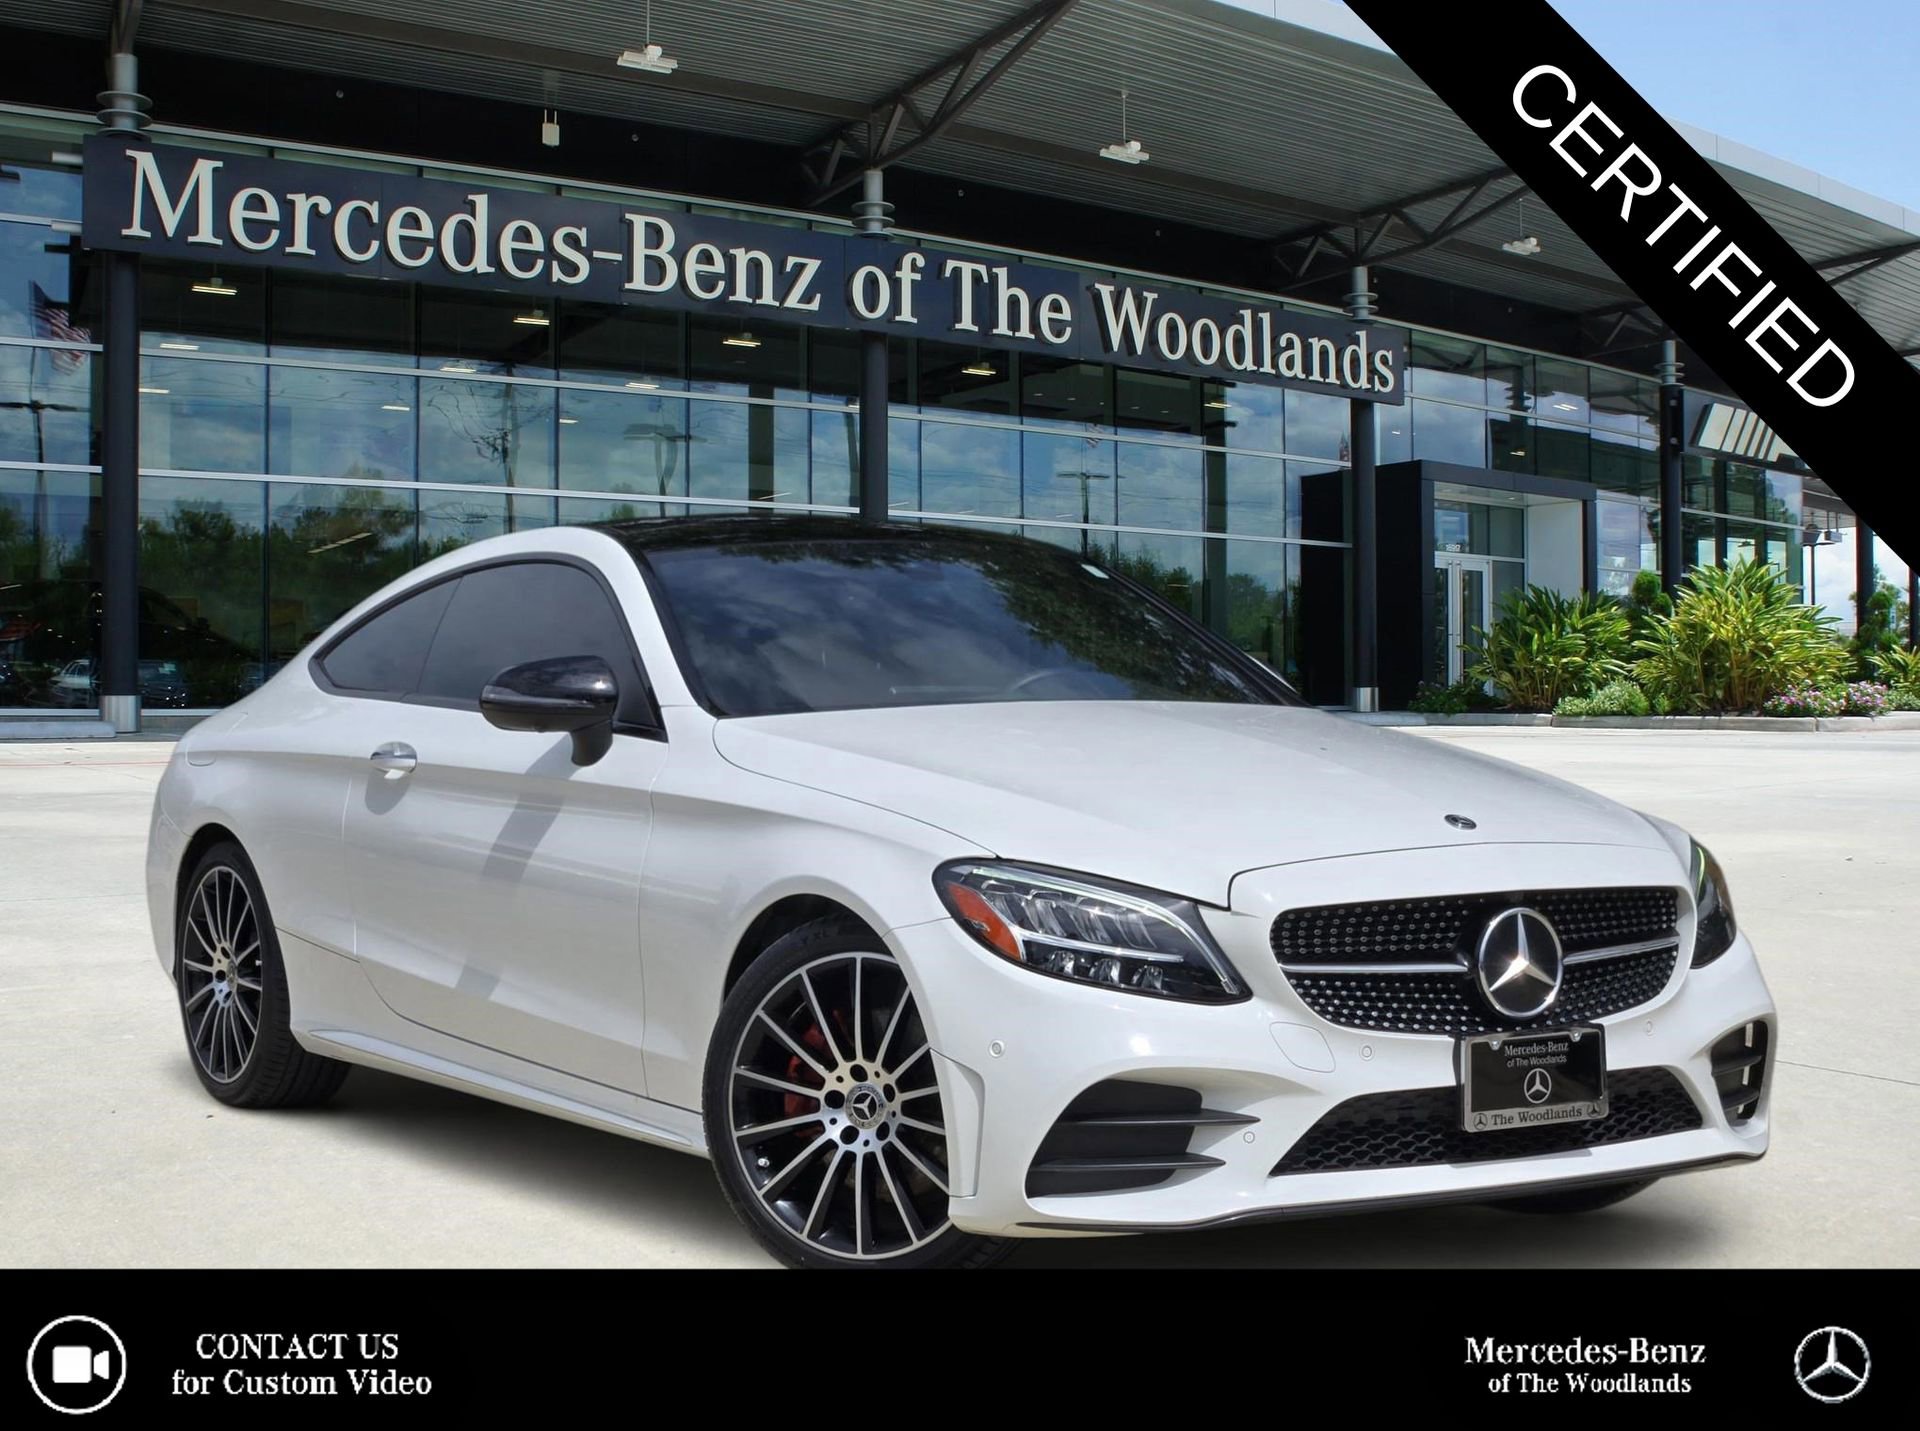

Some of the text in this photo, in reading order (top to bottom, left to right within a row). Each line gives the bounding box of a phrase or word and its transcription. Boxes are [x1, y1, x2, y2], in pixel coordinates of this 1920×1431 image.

[121, 149, 1394, 393] Mercedes-Benz of The Woodlands
[1504, 1041, 1569, 1057] Mercedes-Benz
[1506, 1055, 1567, 1068] of The Woodlands
[1491, 1105, 1583, 1126] The Woodlands
